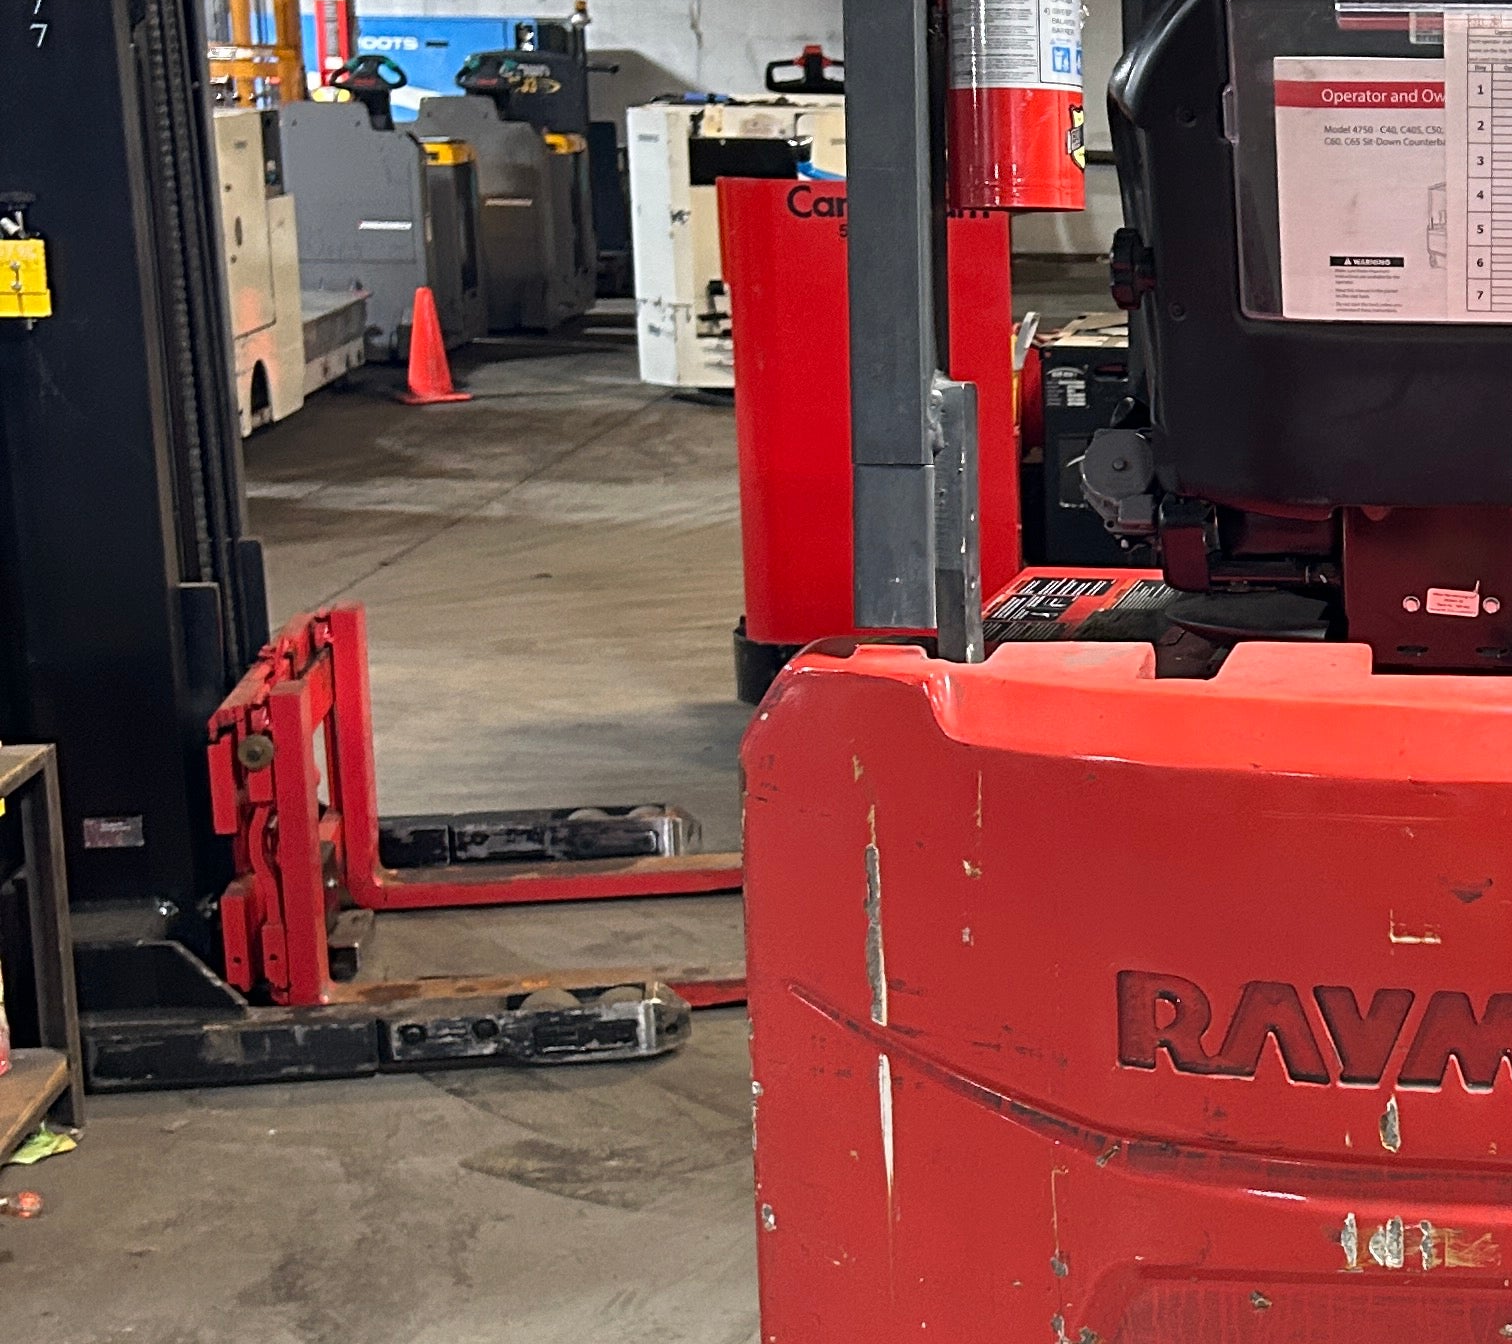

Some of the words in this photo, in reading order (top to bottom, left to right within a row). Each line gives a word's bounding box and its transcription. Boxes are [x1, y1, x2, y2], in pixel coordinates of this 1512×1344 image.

[357, 35, 419, 51] OOTS
[1477, 84, 1484, 95] 1
[1321, 88, 1388, 106] Operator
[1390, 88, 1418, 103] and
[1477, 120, 1484, 131] 2
[1477, 156, 1484, 166] 3
[1476, 190, 1484, 200] 4
[1476, 224, 1484, 235] 5
[1476, 258, 1484, 268] 6
[1476, 290, 1484, 300] 7
